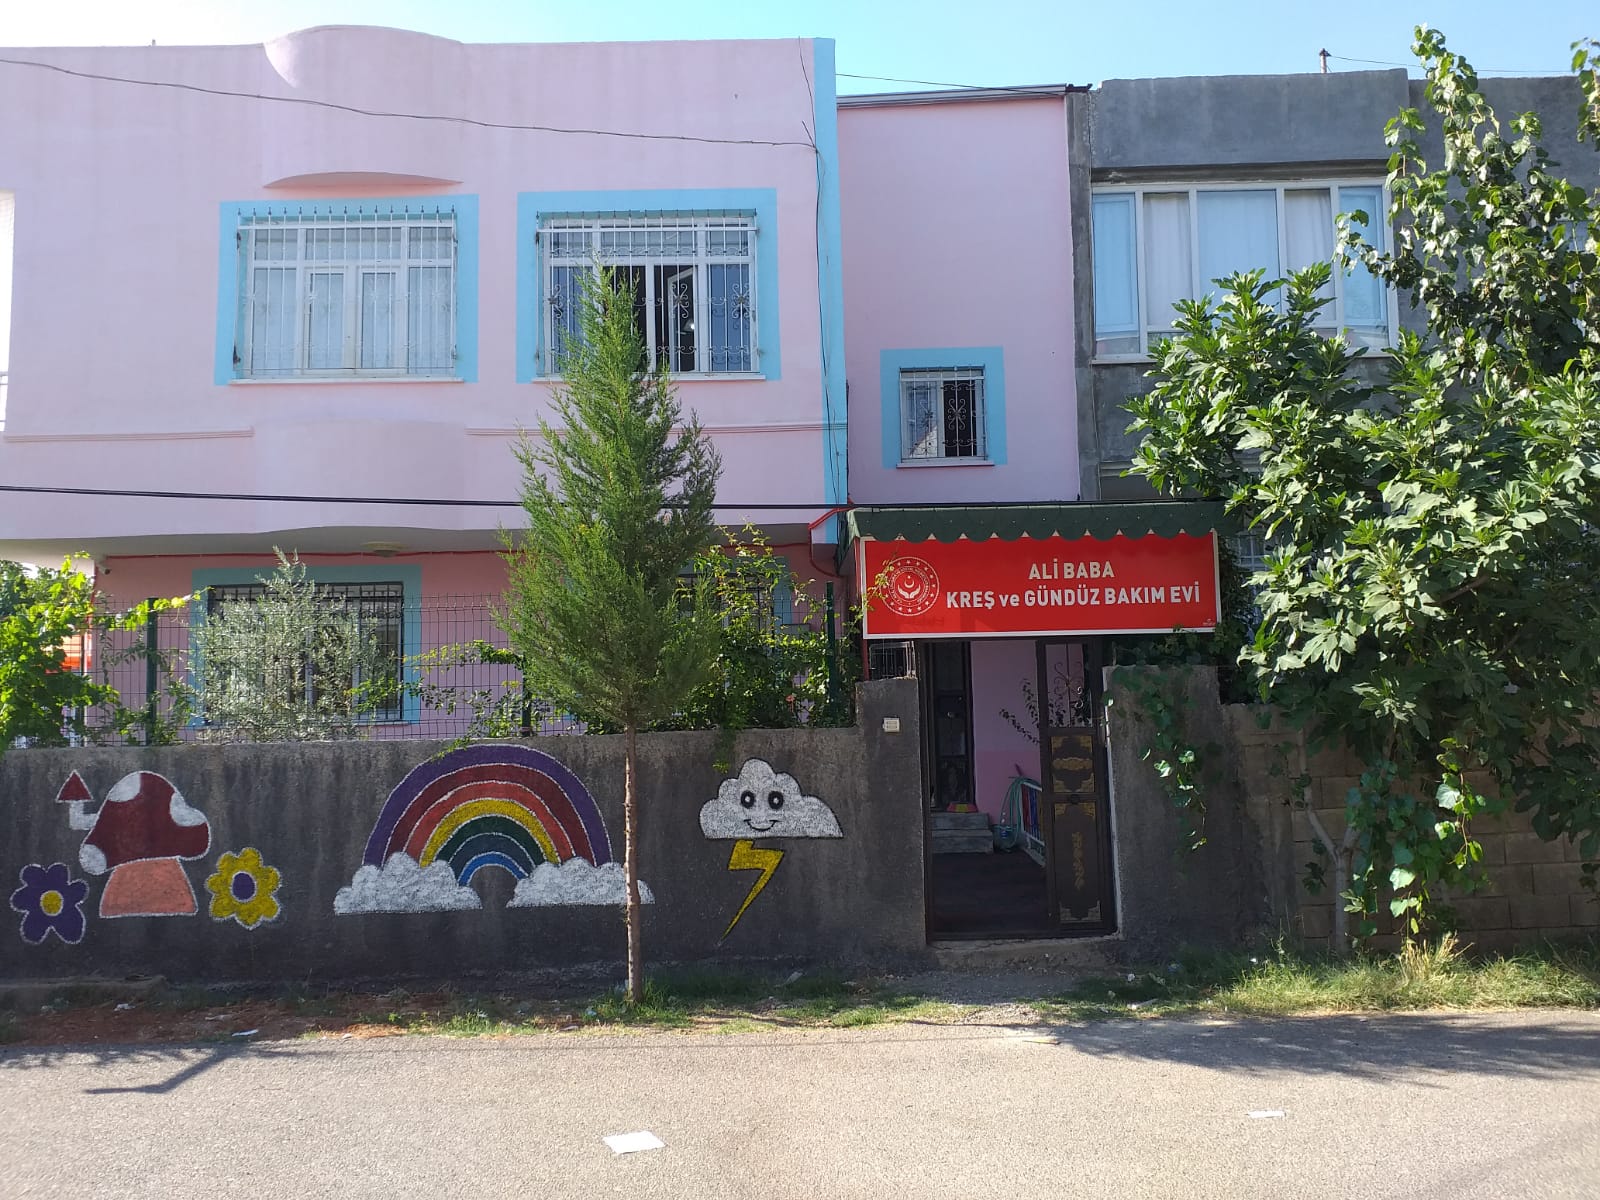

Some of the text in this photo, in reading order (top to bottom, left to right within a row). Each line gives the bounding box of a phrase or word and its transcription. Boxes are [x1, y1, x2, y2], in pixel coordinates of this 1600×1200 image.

[1028, 558, 1115, 580] ALİ BABA
[946, 581, 1200, 610] KREŞ ve GÜNDÜZ BAKIM EVİ
